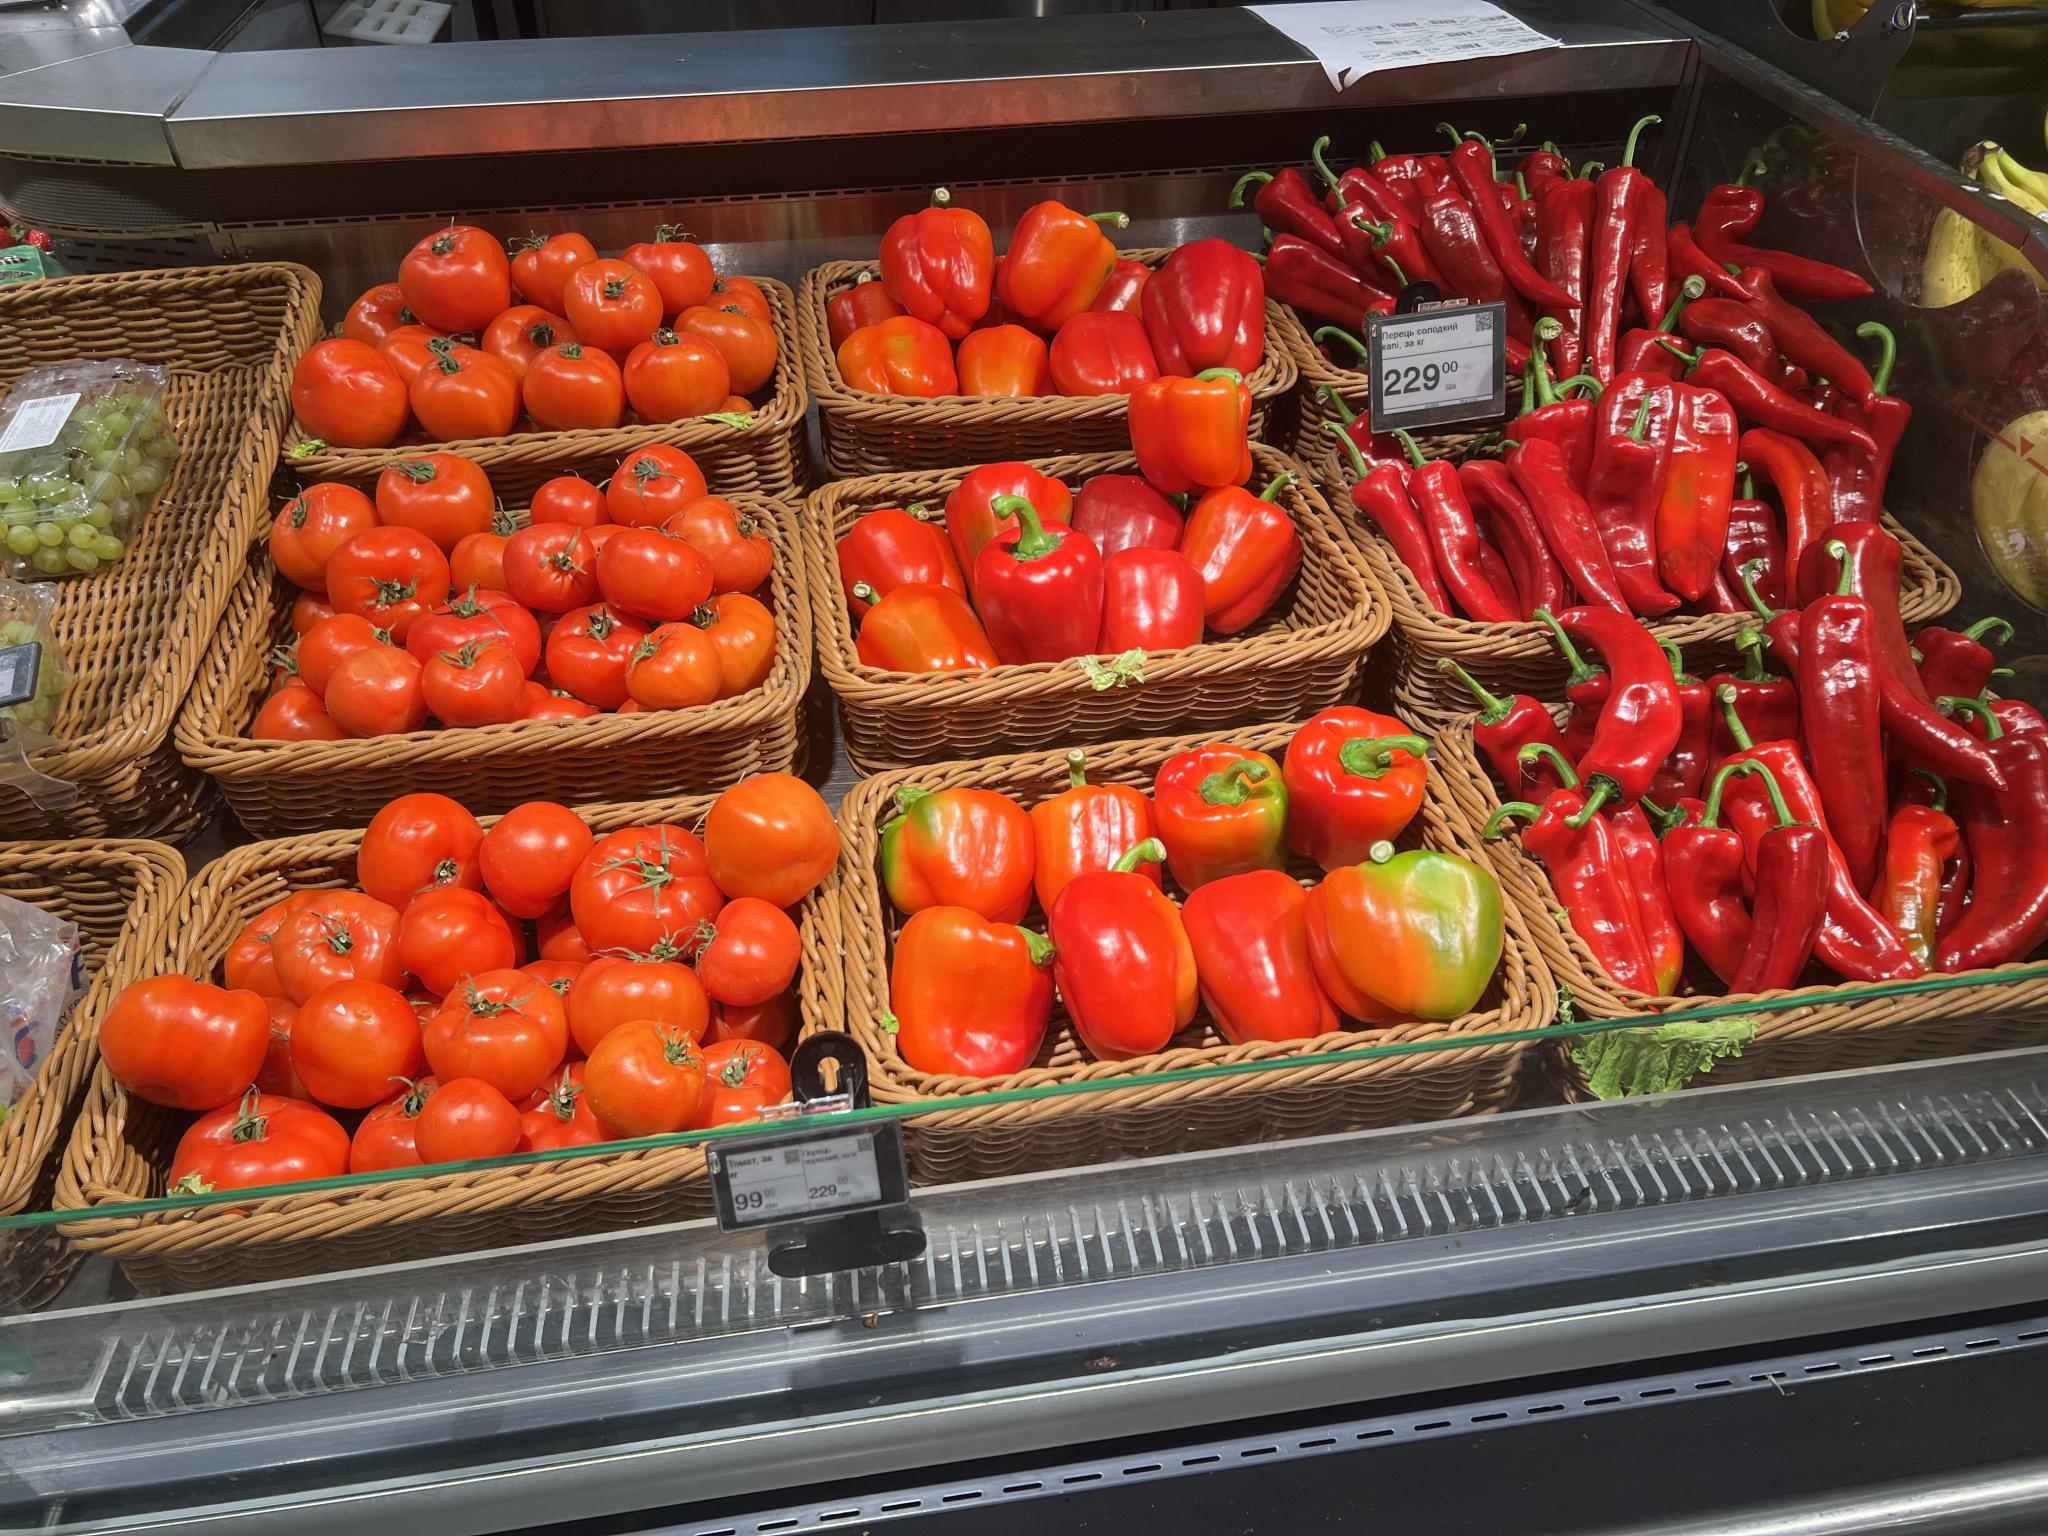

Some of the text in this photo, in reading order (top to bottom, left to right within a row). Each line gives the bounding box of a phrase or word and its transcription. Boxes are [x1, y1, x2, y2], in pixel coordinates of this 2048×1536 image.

[1382, 322, 1458, 341] Перець солодкий
[1384, 360, 1459, 397] 229 00
[734, 1191, 763, 1211] 99
[809, 1184, 837, 1200] 229
